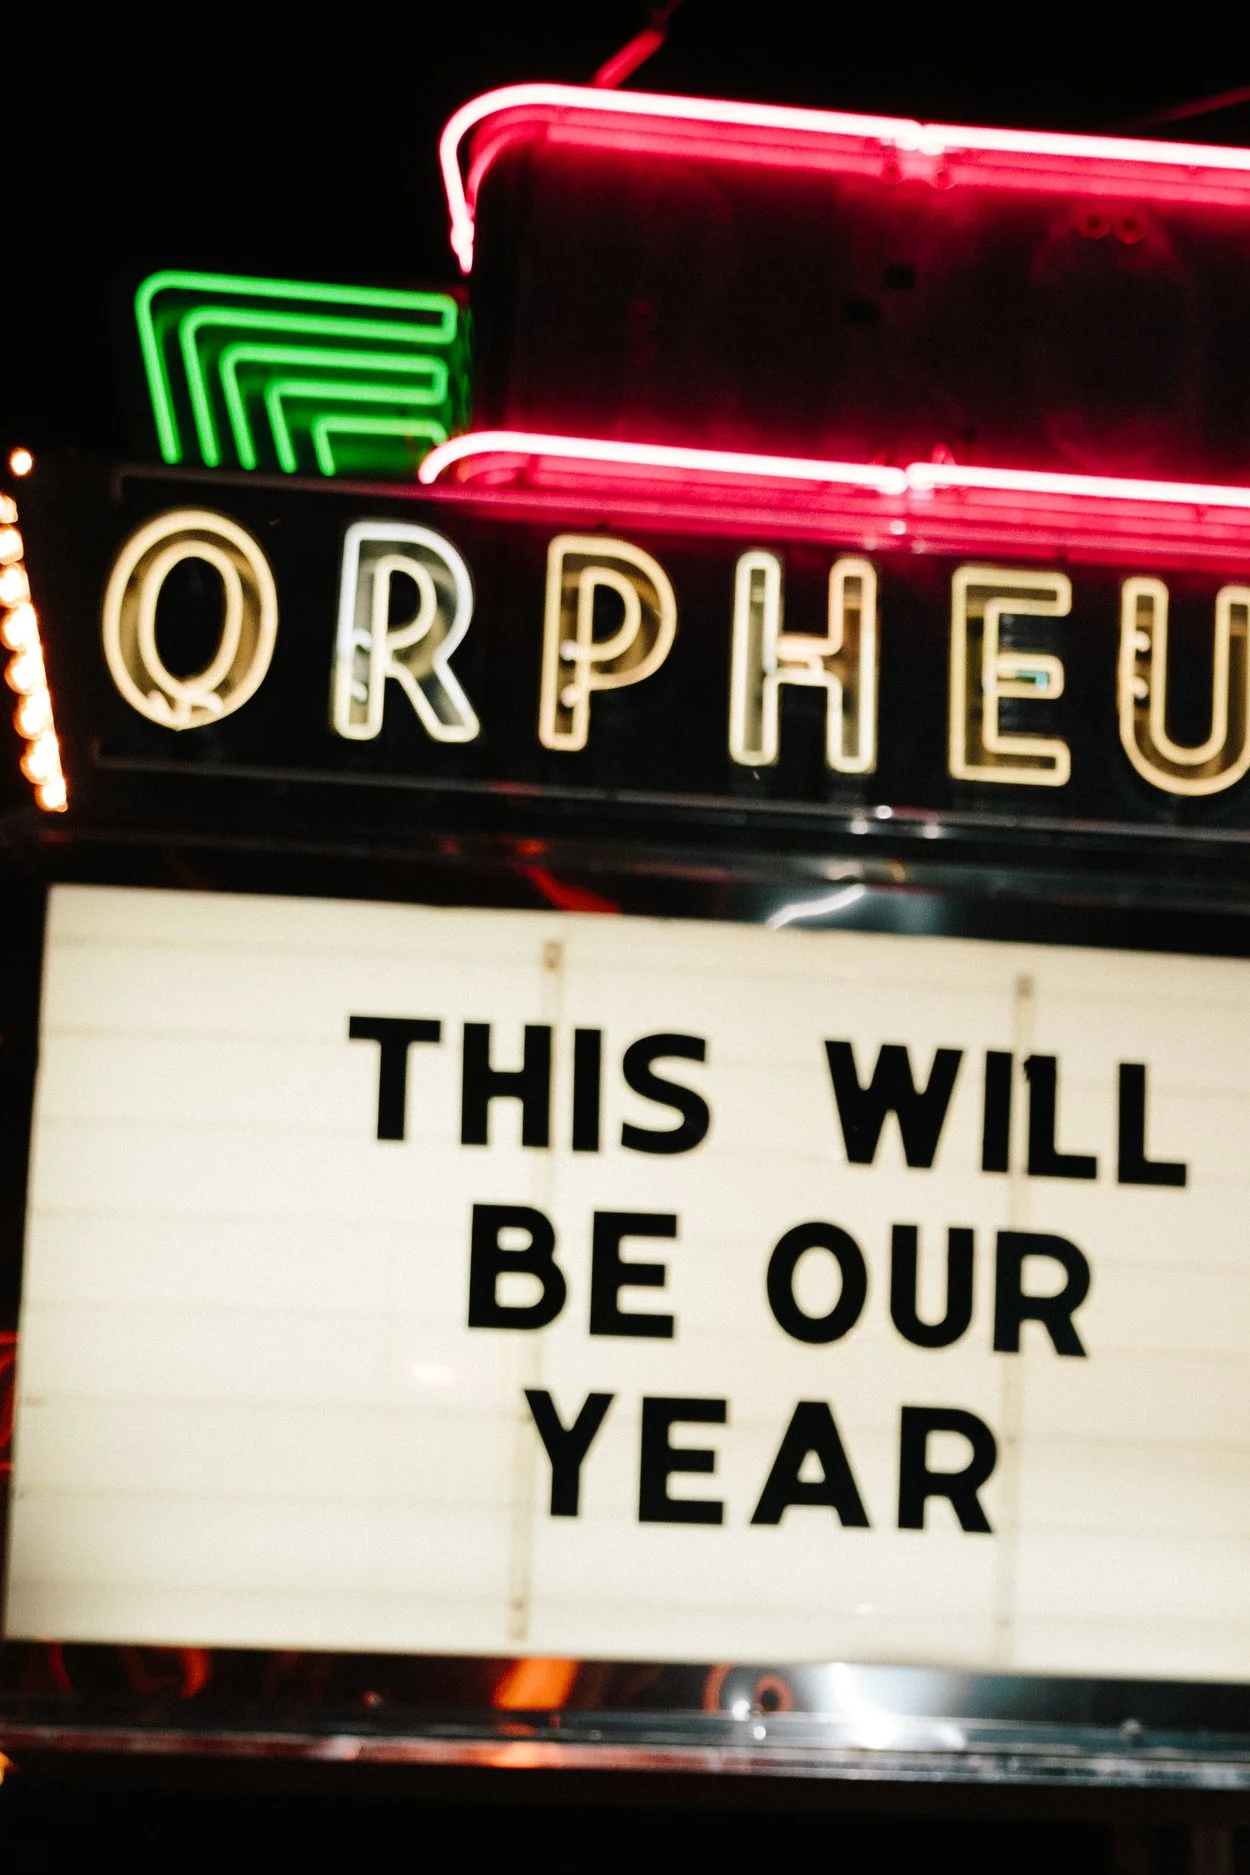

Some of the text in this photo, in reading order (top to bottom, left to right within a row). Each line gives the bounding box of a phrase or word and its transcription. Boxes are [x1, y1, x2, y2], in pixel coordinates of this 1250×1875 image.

[348, 1015, 1188, 1189] THIS WILL
[467, 1203, 1091, 1358] BE OUR
[523, 1389, 998, 1534] YEAR
